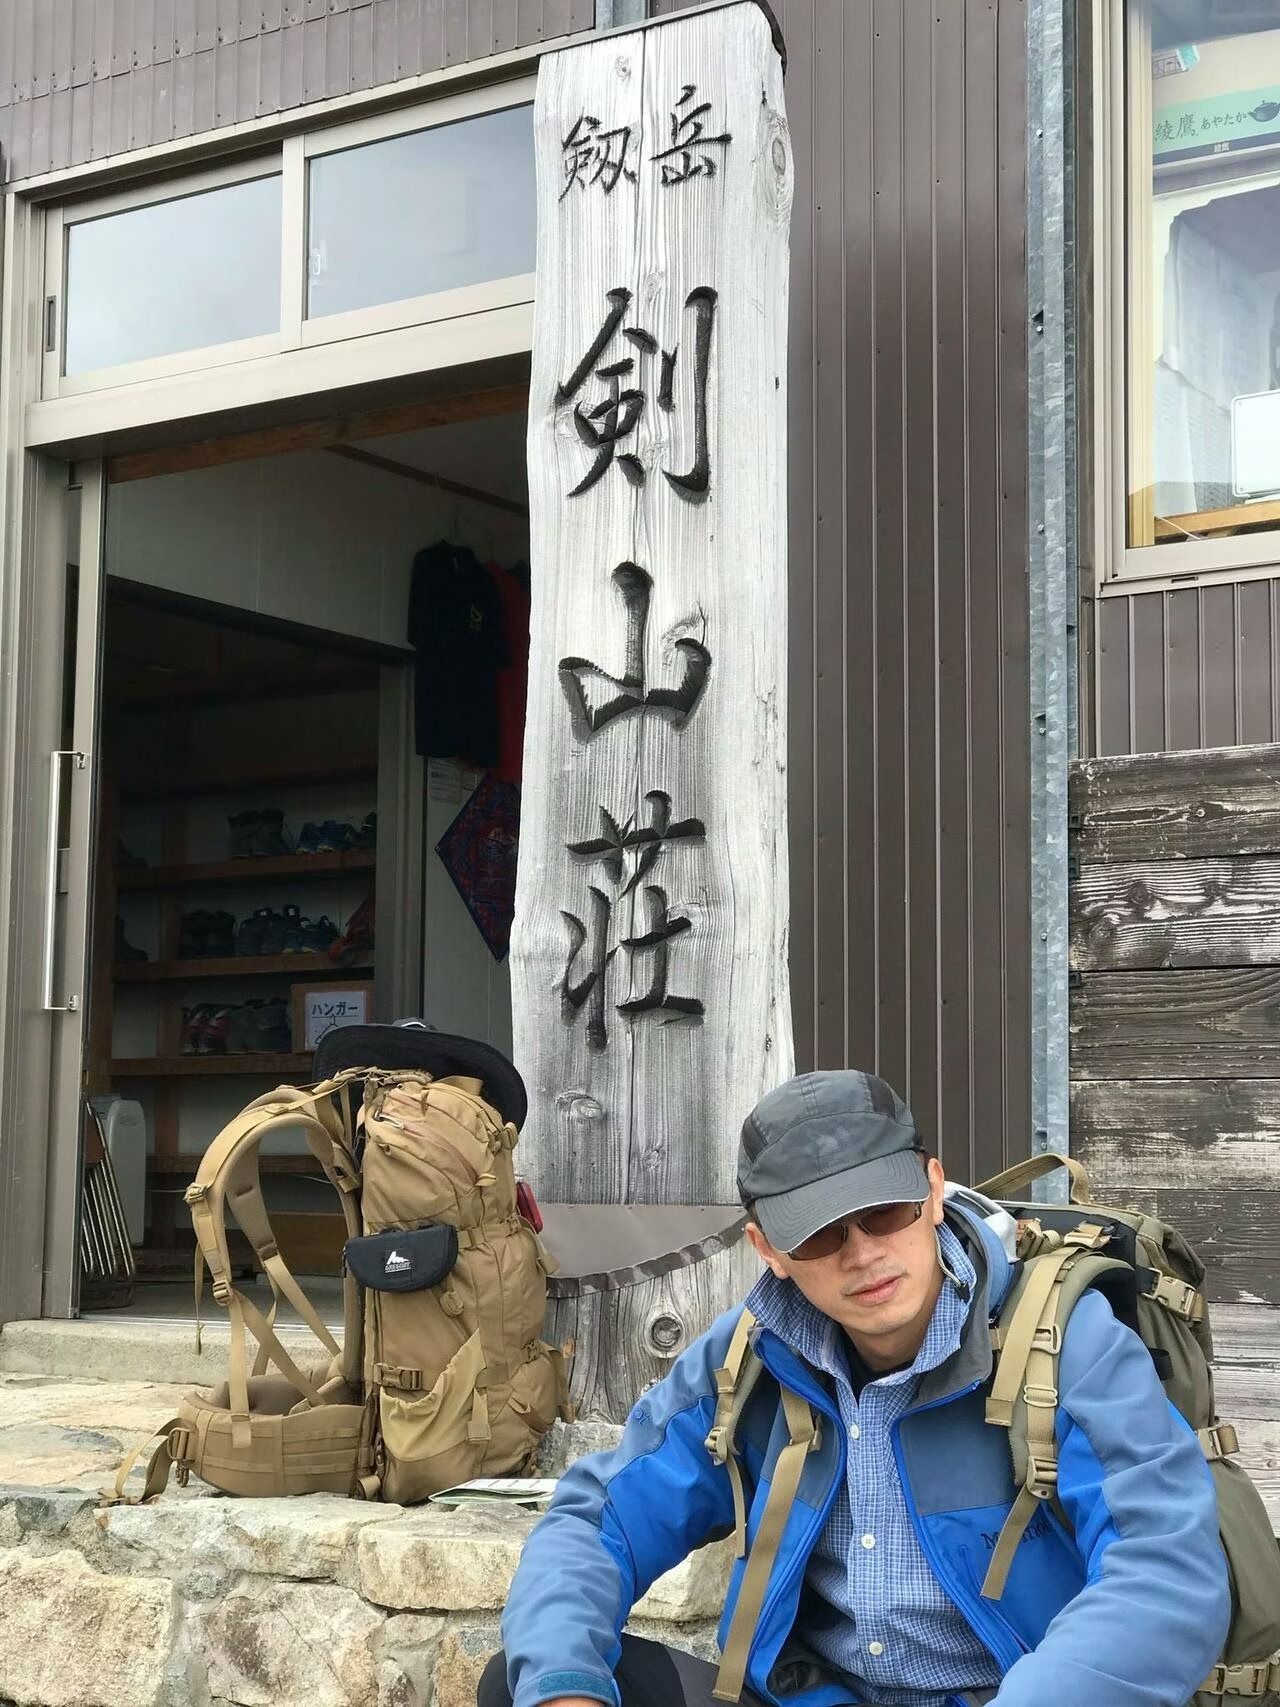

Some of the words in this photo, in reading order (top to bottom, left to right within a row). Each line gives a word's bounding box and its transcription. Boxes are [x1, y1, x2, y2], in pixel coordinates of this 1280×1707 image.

[1154, 113, 1198, 141] 綾鷹
[1201, 112, 1247, 130] あやたか
[554, 286, 719, 1049] 剣山荘
[312, 1001, 359, 1016] ハンガー
